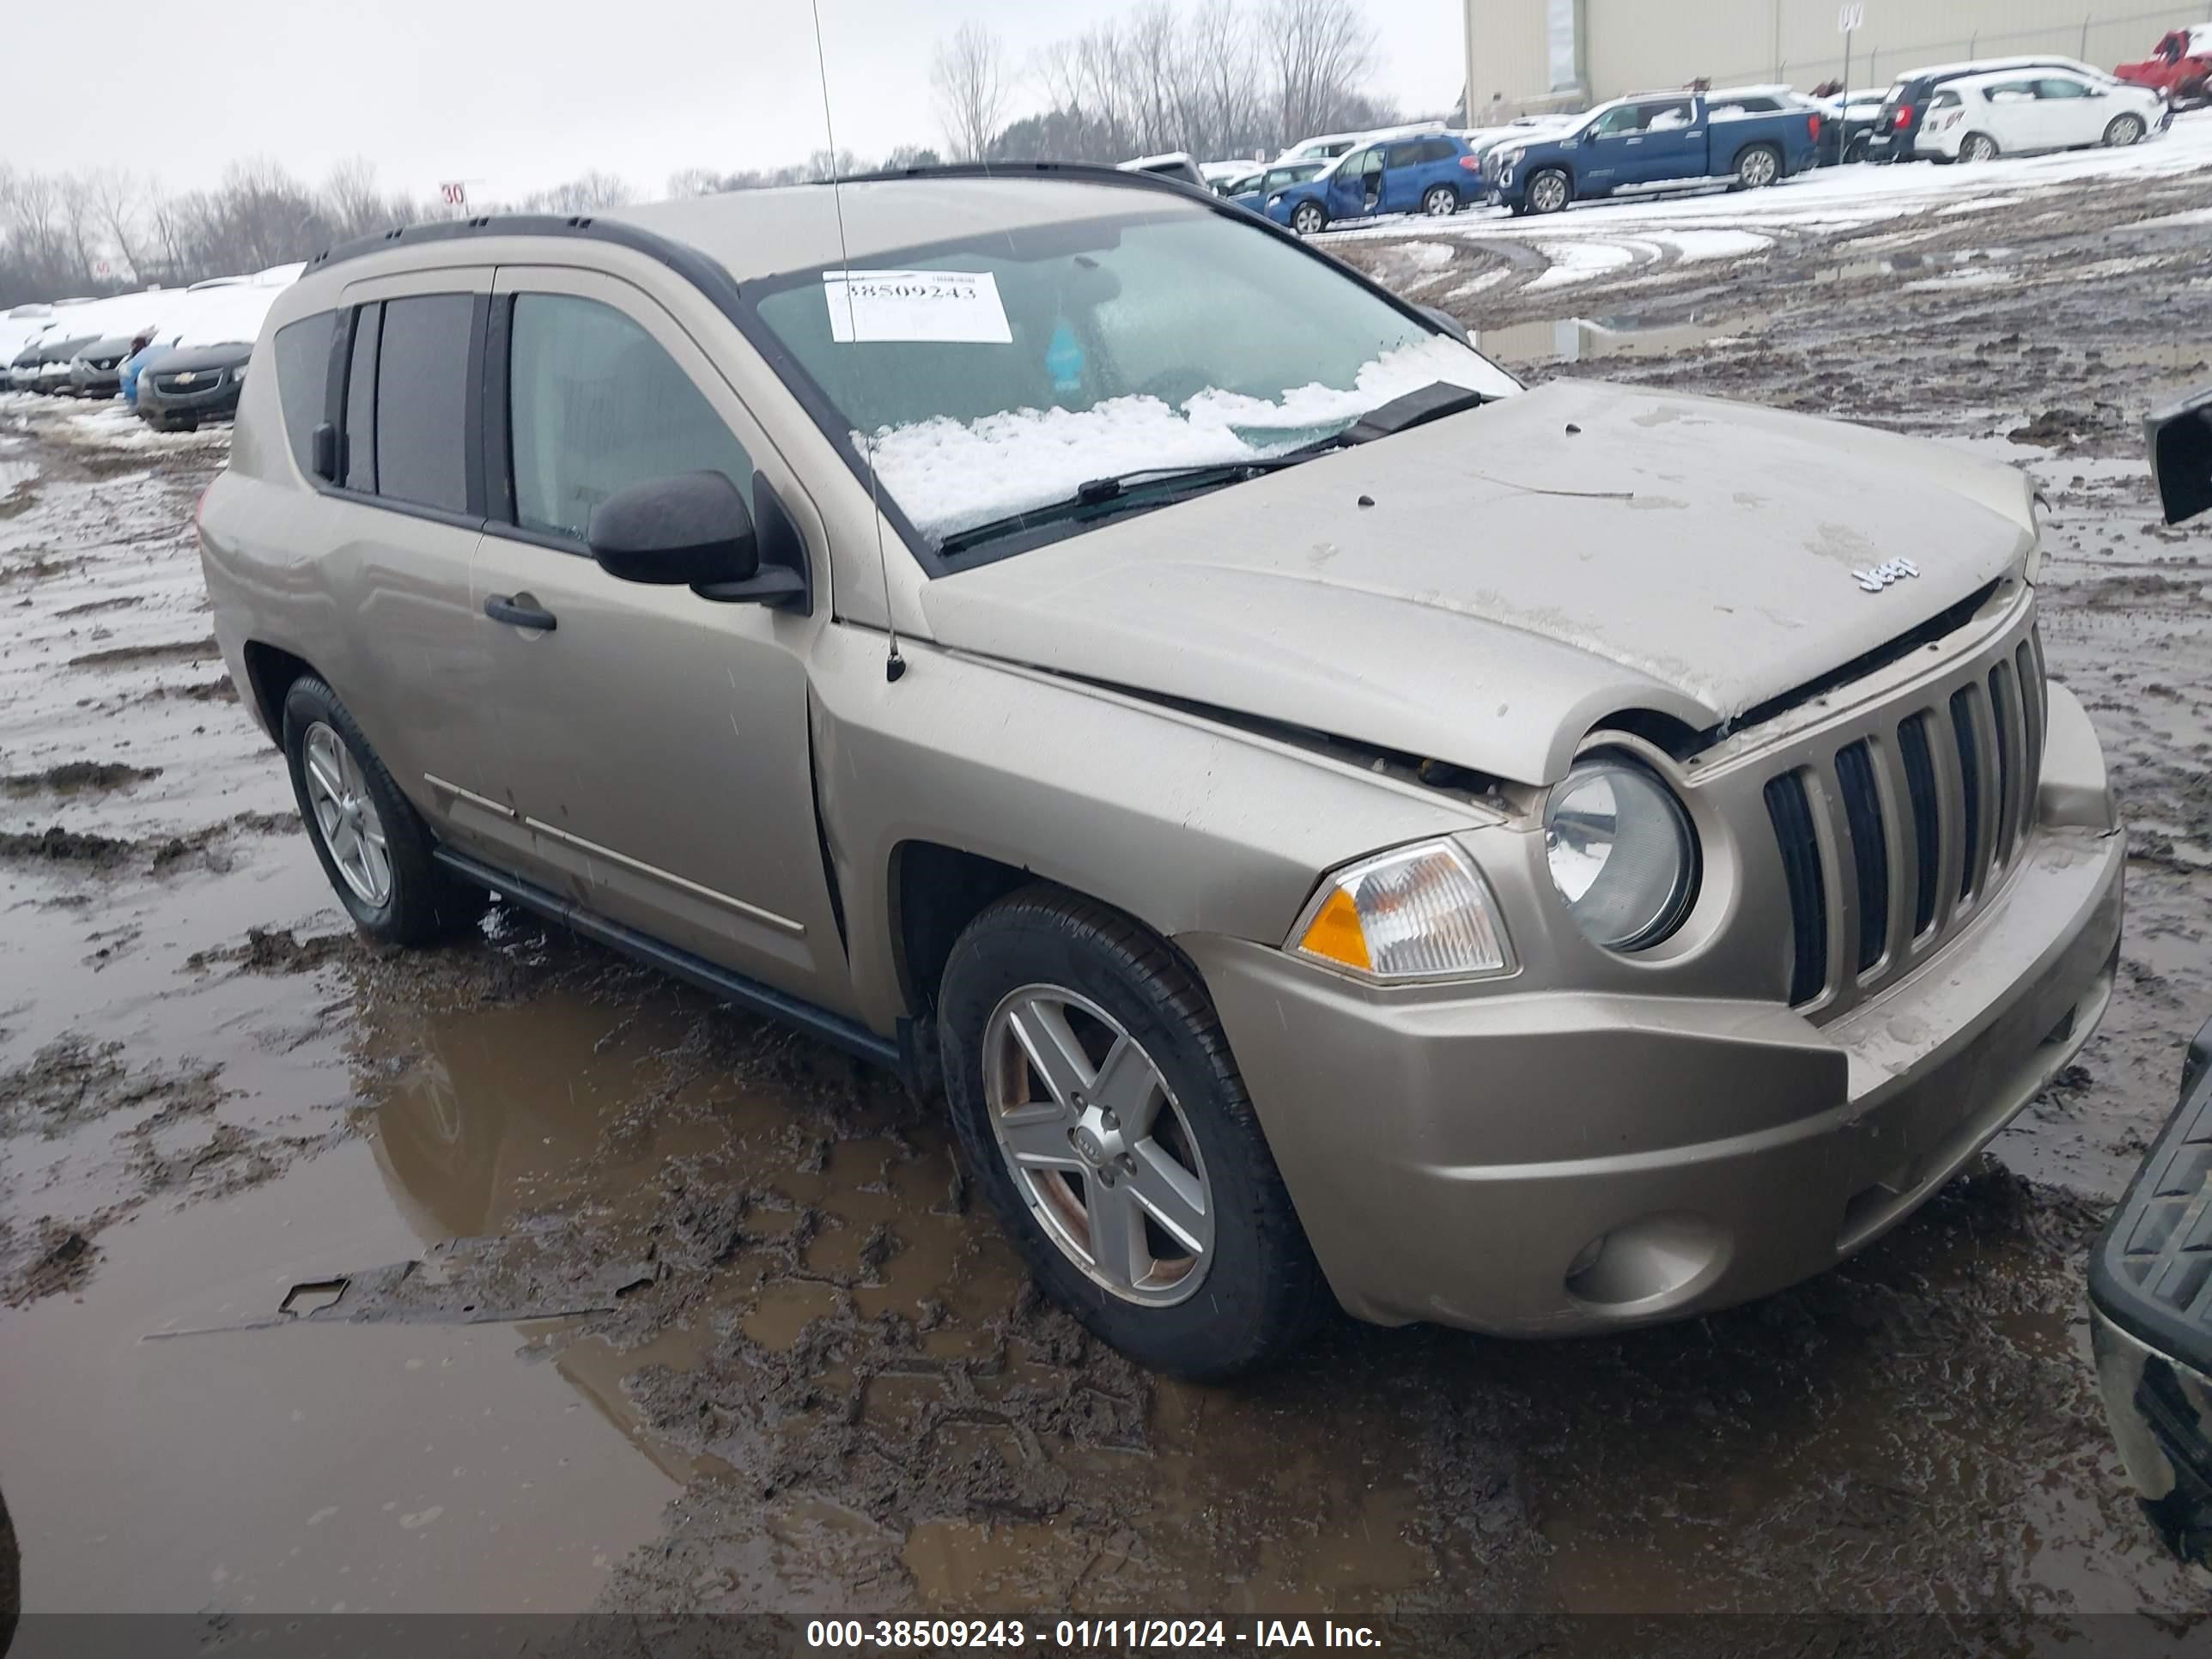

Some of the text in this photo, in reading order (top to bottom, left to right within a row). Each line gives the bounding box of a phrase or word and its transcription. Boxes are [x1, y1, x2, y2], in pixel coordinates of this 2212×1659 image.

[441, 183, 465, 205] 30
[848, 283, 977, 300] 38509243
[1851, 556, 1920, 592] Jeep
